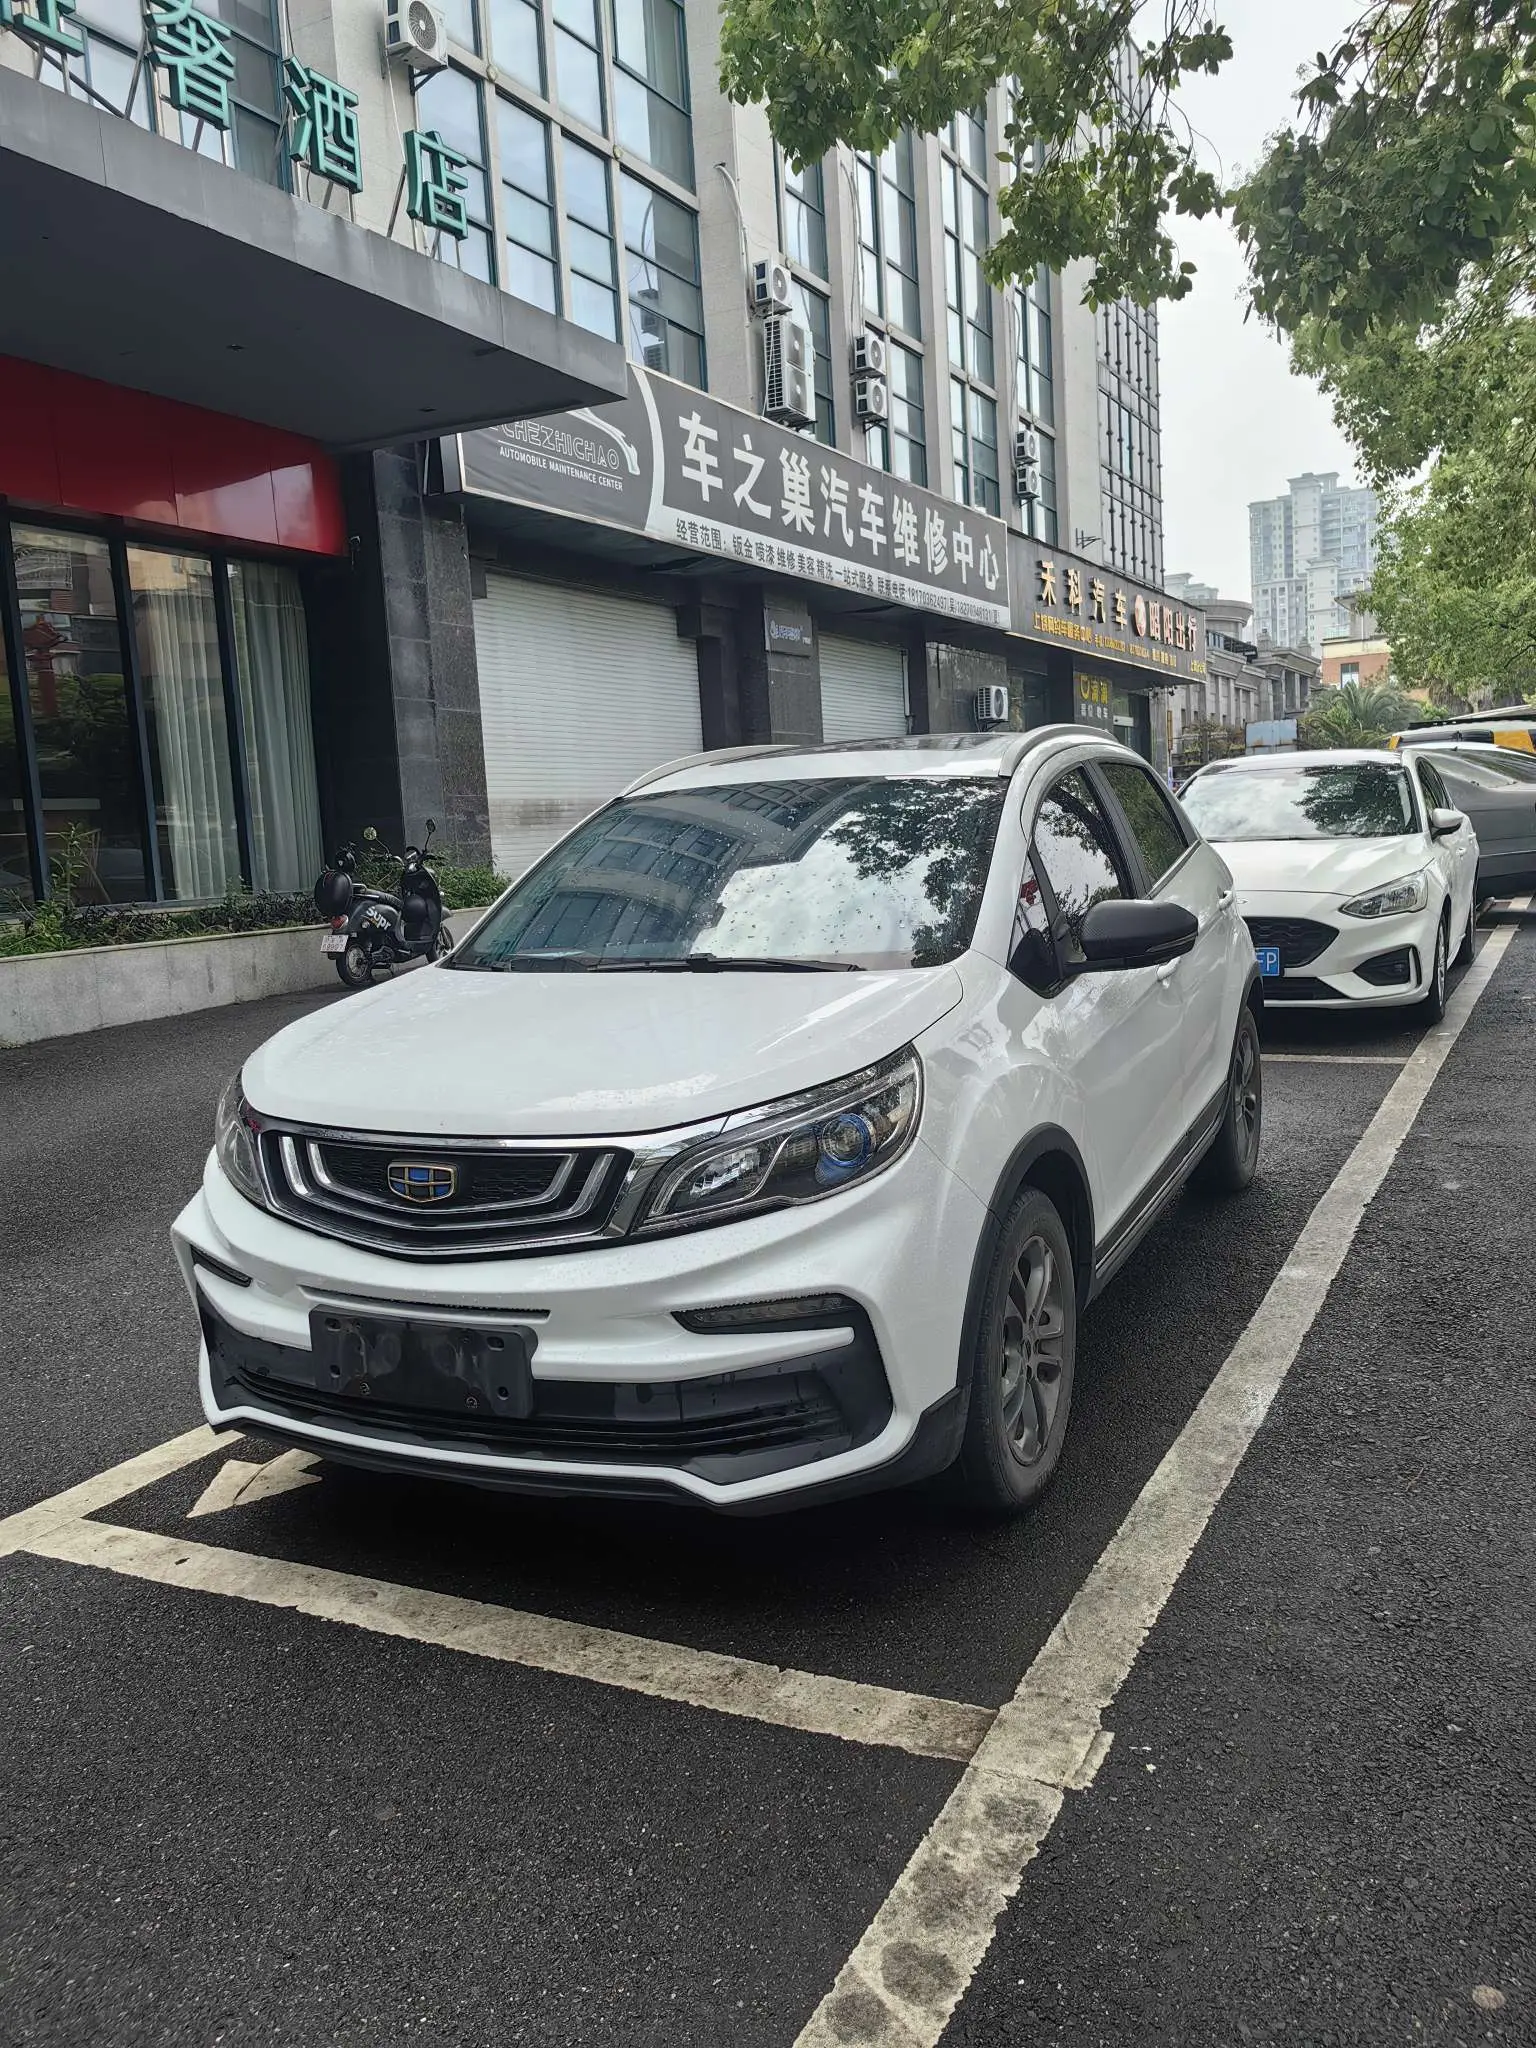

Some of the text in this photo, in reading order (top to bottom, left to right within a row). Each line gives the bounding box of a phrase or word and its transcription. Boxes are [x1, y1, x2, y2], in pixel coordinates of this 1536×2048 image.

[500, 446, 623, 491] AUTOMOBILE MAINTENANCE CENTER
[679, 411, 1000, 590] 车之巢汽车维修中心
[777, 546, 796, 570] 维修
[797, 553, 815, 576] 美容
[835, 566, 874, 593] 一站式服务
[1040, 560, 1127, 630] 禾科汽车
